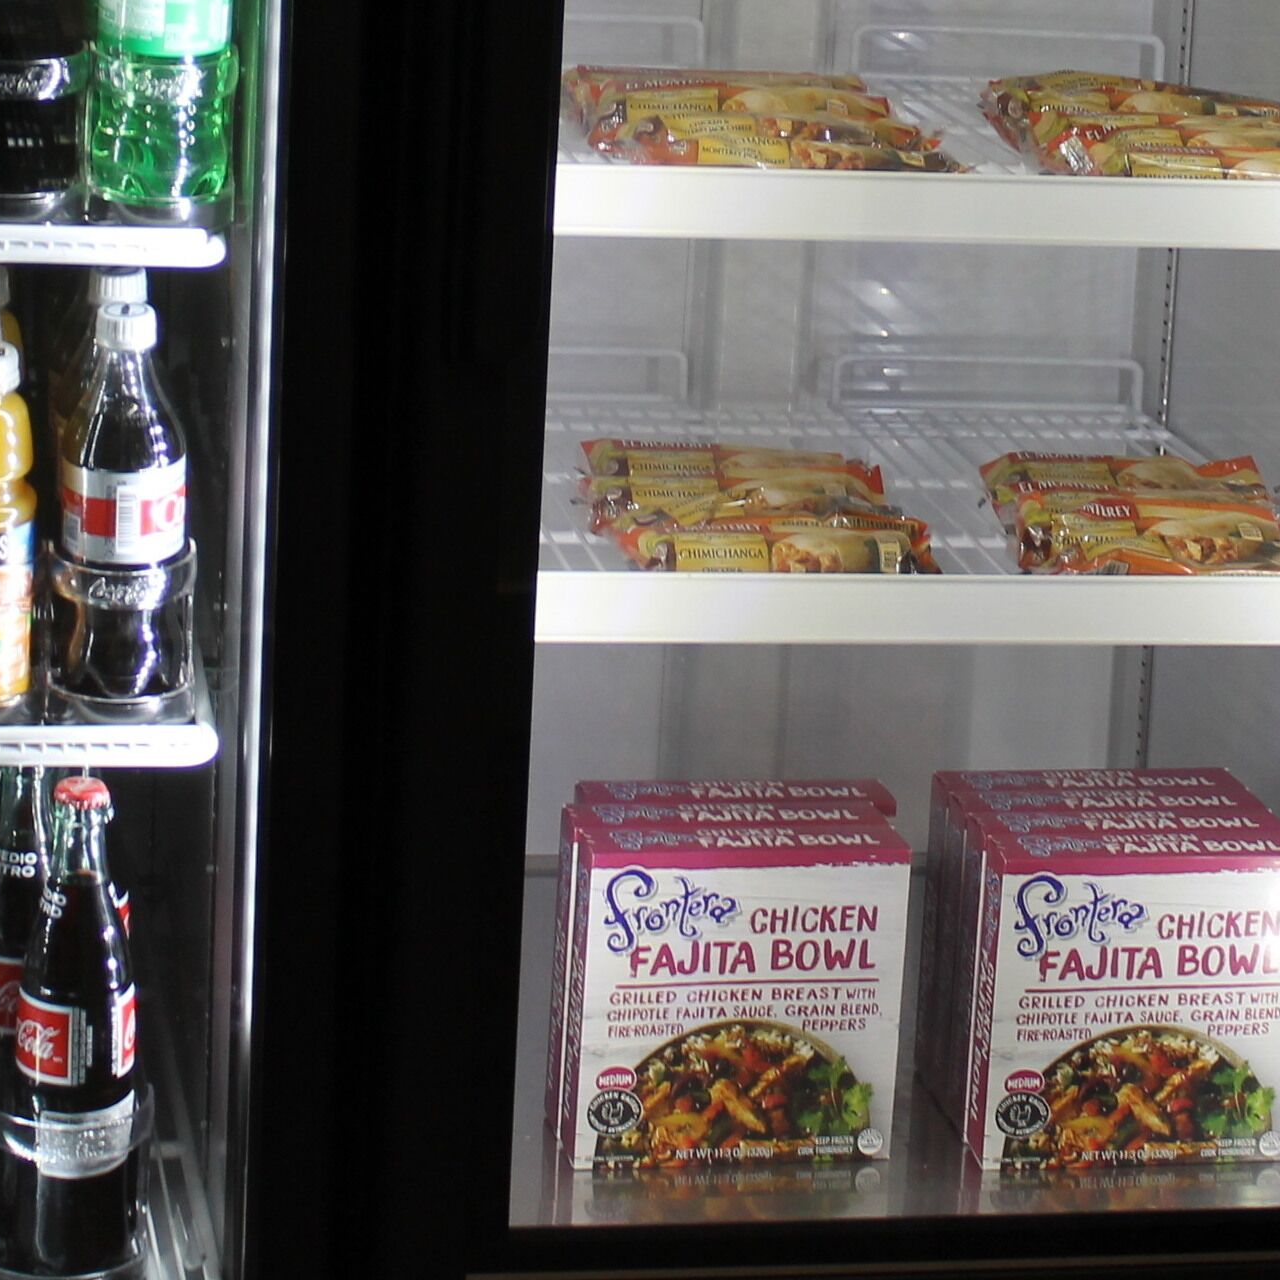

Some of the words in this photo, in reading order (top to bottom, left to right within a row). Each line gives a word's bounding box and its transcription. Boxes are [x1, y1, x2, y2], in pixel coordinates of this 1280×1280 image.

[679, 548, 764, 559] CHIMICHANGA
[692, 787, 785, 799] FAJITA
[788, 786, 868, 798] BOWL
[679, 808, 775, 823] FAJITA
[779, 808, 861, 820] BOWL
[1084, 818, 1175, 831] FAJITA
[1178, 816, 1260, 829] BOWL
[695, 833, 796, 848] FAJITA
[799, 832, 881, 846] BOWL
[1106, 840, 1198, 854] FAJITA
[604, 869, 737, 952] Frontera
[1014, 875, 1146, 957] Frontera
[751, 905, 879, 935] CHICKEN
[630, 940, 756, 978] FAJITA
[771, 939, 876, 972] BOWL
[1039, 946, 1163, 982] FAJITA
[1177, 944, 1279, 977] BOWL
[610, 991, 677, 1006] GRILLED
[687, 988, 762, 1003] CHICKEN
[772, 987, 843, 1001] BREAST
[847, 987, 876, 1000] WITH
[1019, 994, 1085, 1009] GRILLED
[1095, 993, 1169, 1008] CHICKEN
[1178, 992, 1246, 1007] BREAST
[1250, 992, 1279, 1004] WITH
[607, 1008, 668, 1022] CHIPOTLE
[676, 1006, 729, 1019] FAJITA
[785, 1004, 836, 1018] GRAIN
[841, 1003, 882, 1017] BLEND,
[1016, 1010, 1078, 1025] CHIPOTLE
[1084, 1010, 1134, 1024] FAJITA
[1190, 1009, 1240, 1022] GRAIN
[801, 1019, 867, 1032] PEPPERS
[1207, 1022, 1269, 1036] PEPPERS
[598, 1073, 633, 1087] MEDIUM
[1008, 1077, 1041, 1090] MEDIUM
